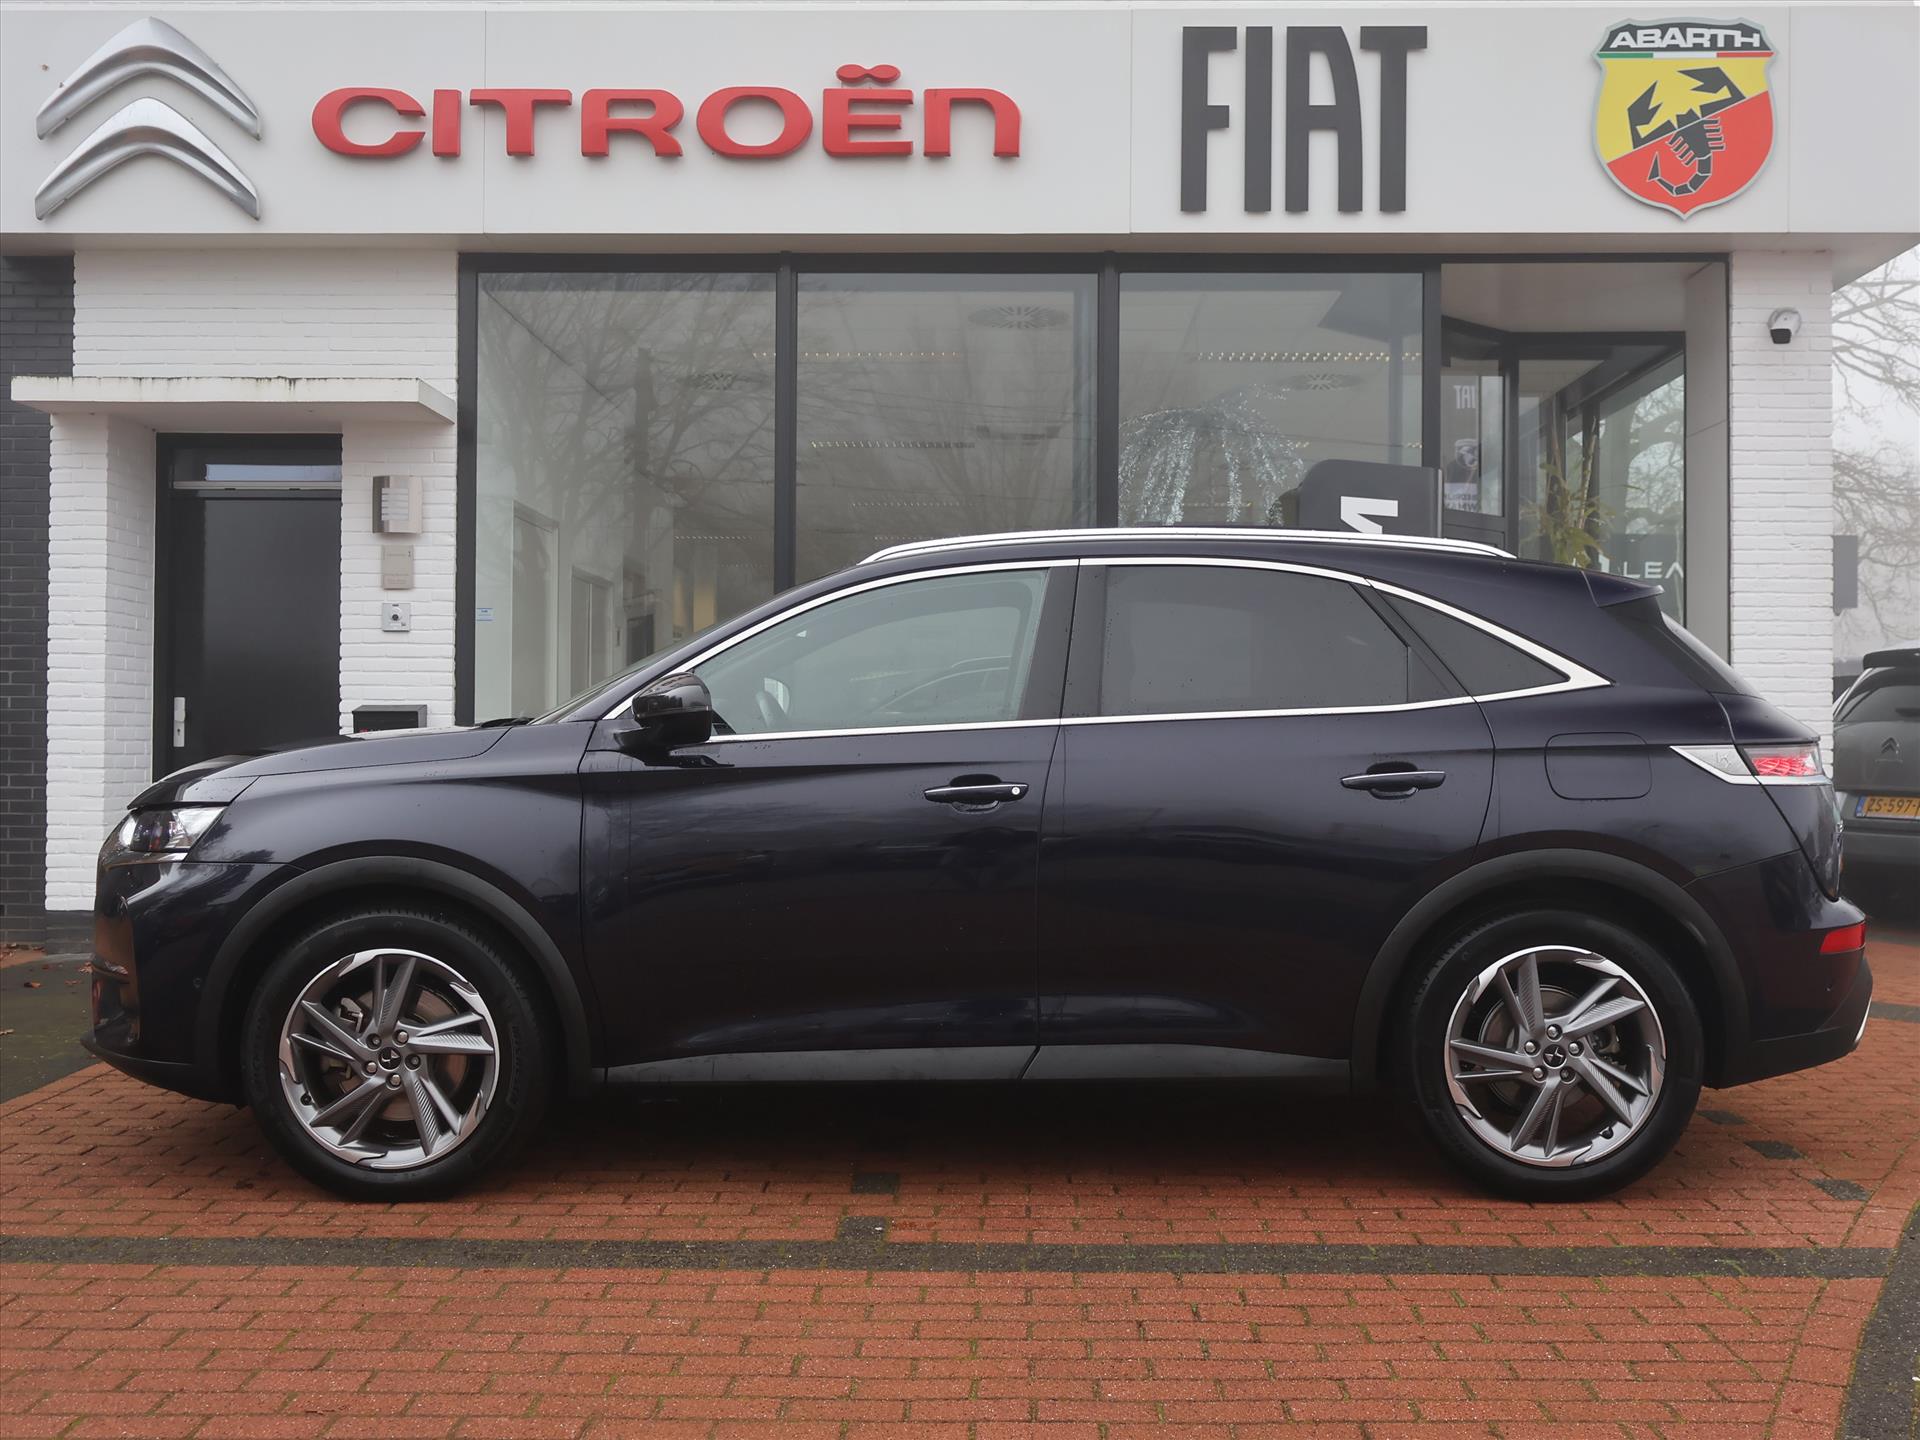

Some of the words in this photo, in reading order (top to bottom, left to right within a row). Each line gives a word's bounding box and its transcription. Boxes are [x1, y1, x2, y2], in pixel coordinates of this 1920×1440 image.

[1609, 26, 1761, 48] ABARTH
[312, 64, 1021, 158] CITROËN
[1181, 26, 1427, 212] FIAT
[1867, 798, 1920, 815] ZS-597-
